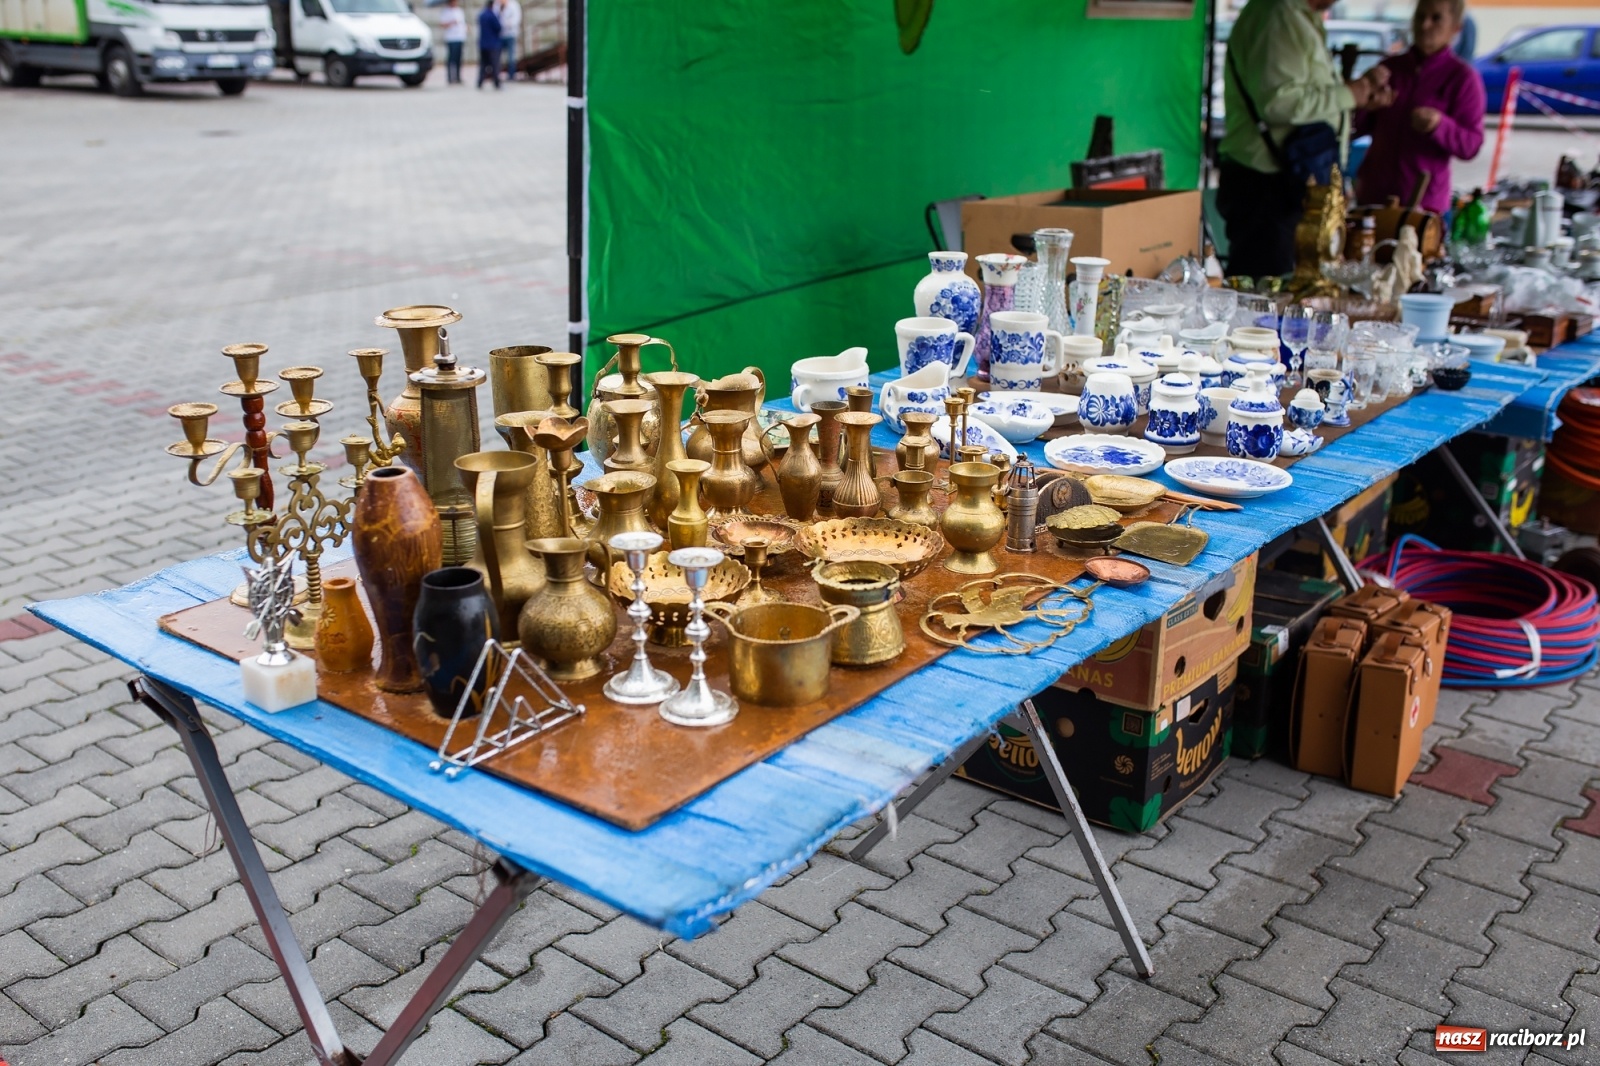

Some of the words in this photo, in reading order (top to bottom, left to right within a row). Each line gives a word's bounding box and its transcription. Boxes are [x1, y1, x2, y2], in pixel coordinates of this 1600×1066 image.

[1167, 613, 1183, 626] CLASS
[1163, 658, 1210, 698] PREMIUM
[1213, 629, 1249, 666] BANANAS
